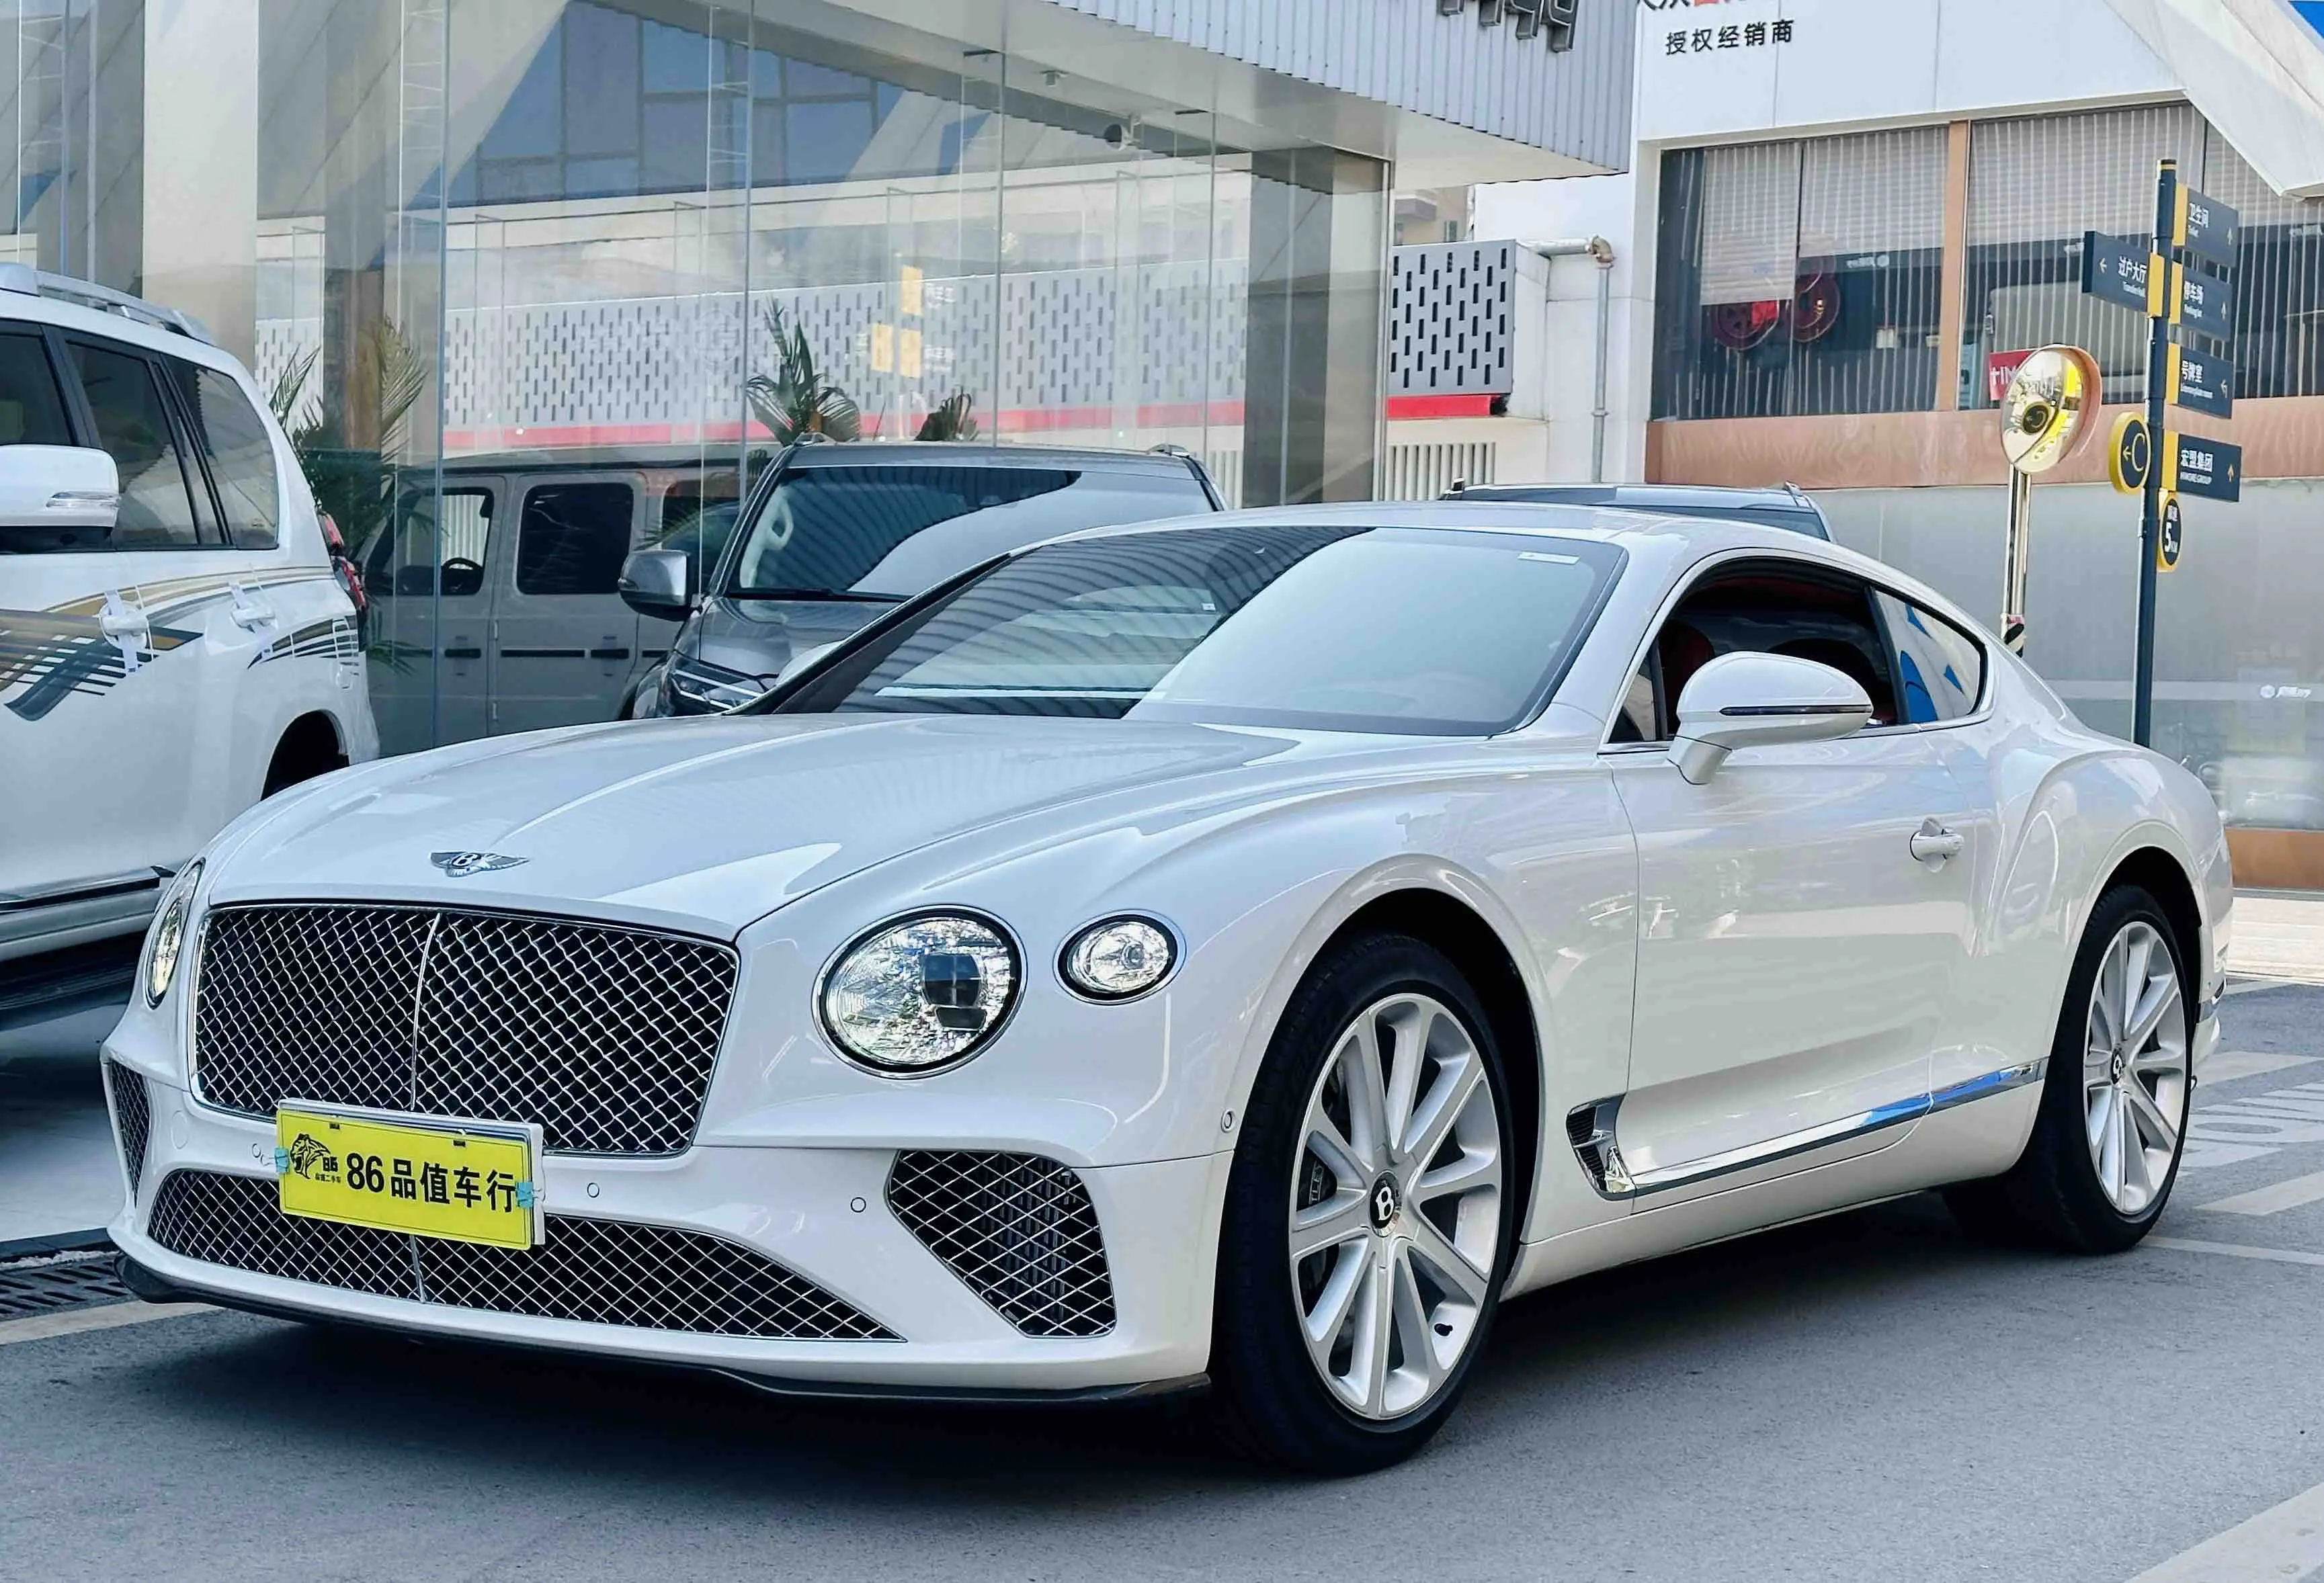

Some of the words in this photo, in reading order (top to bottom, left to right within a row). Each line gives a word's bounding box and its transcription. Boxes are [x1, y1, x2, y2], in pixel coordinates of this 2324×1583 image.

[1666, 19, 1794, 55] 授权经销商
[2118, 256, 2147, 284] 过户大厅
[347, 1152, 516, 1212] 86品值车行
